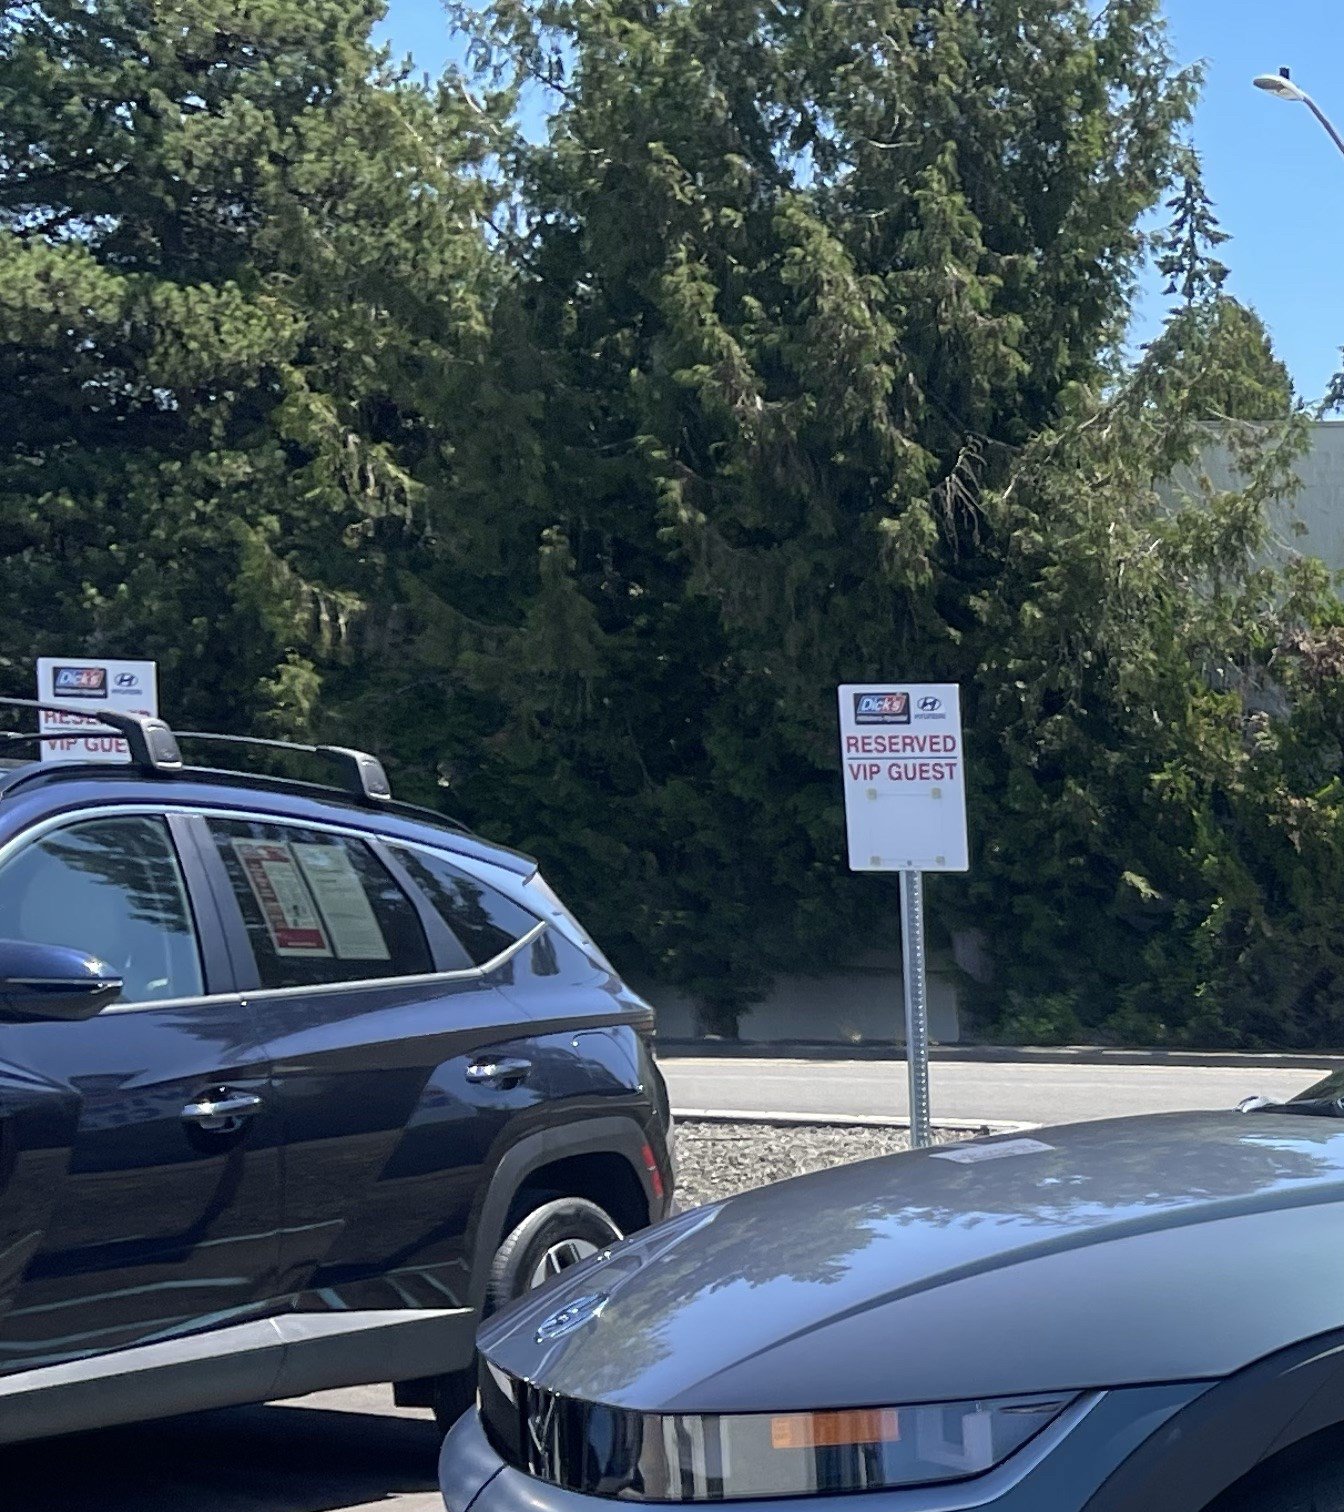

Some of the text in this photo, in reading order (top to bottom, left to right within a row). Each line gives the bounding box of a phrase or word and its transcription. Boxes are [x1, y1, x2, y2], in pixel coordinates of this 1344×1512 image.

[846, 735, 957, 753] RESERVED
[848, 762, 957, 781] VIP GUEST
